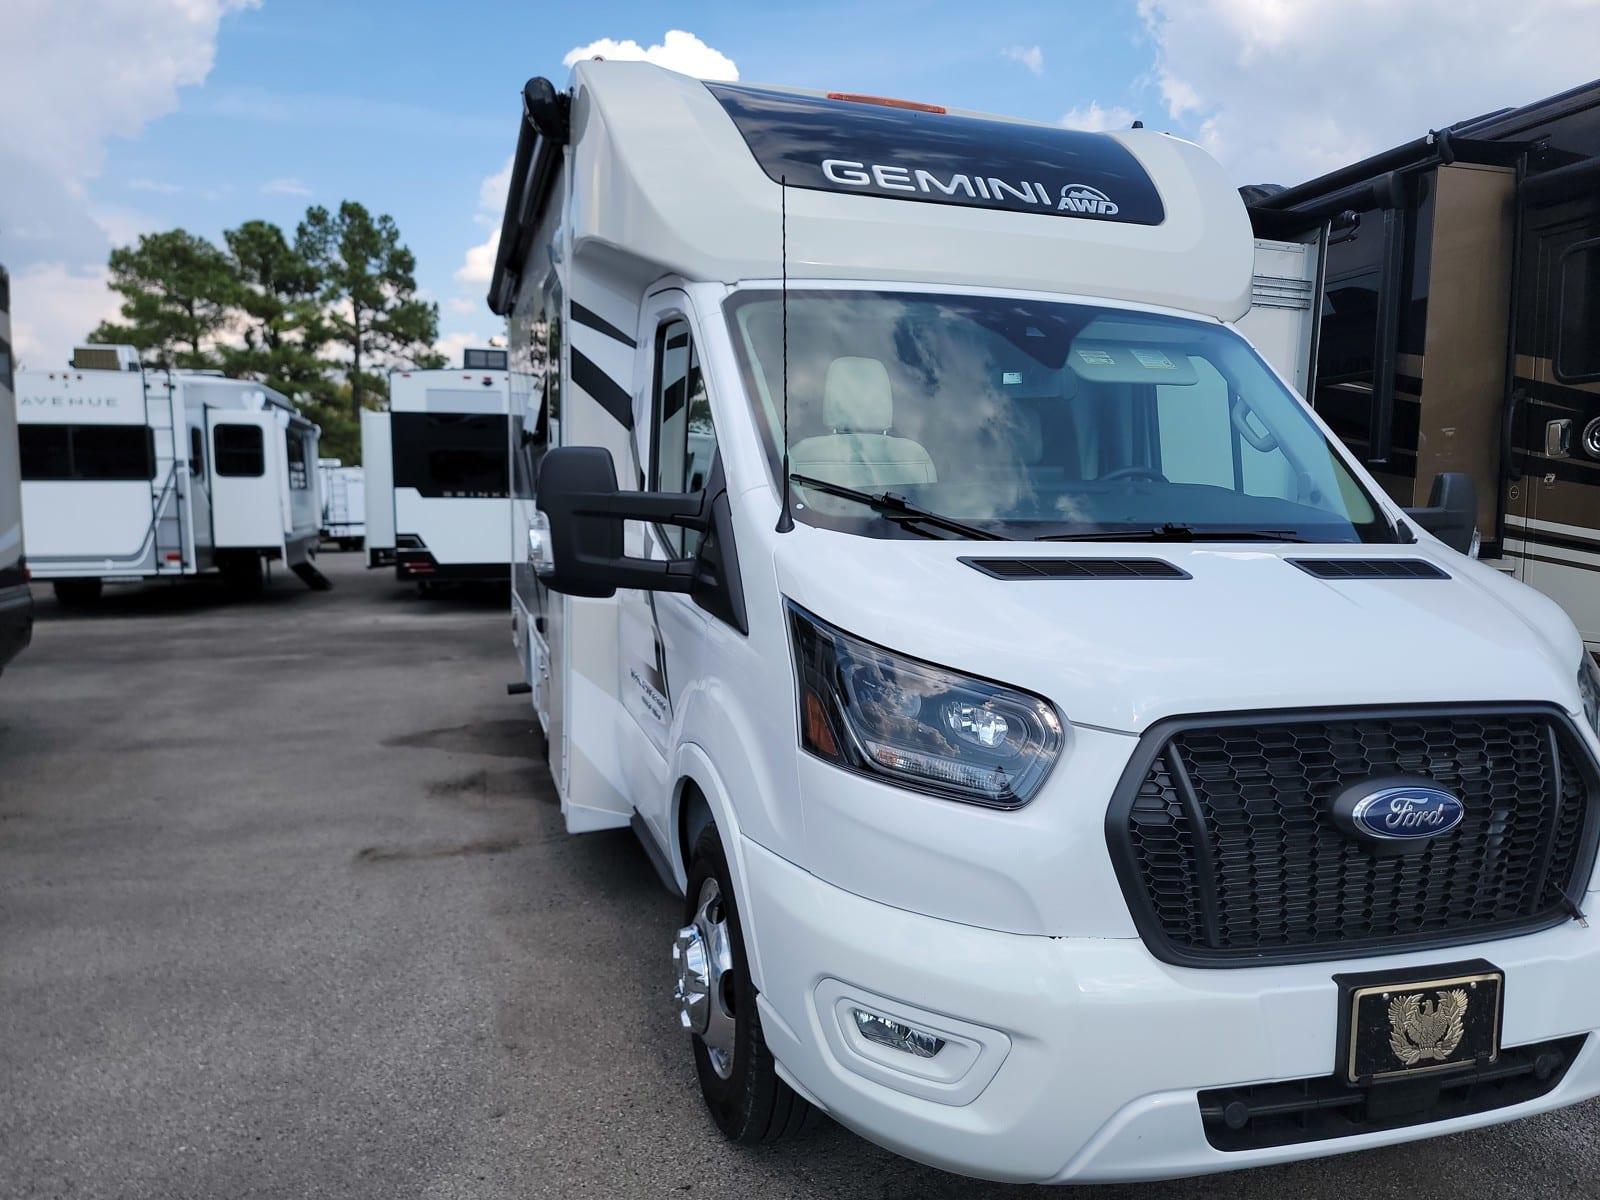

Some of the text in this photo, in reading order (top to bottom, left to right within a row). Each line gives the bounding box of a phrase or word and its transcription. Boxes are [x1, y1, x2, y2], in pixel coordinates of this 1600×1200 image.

[821, 158, 1119, 215] GEMINI AWD
[21, 396, 119, 407] AVENUE
[1385, 797, 1444, 829] Ford
